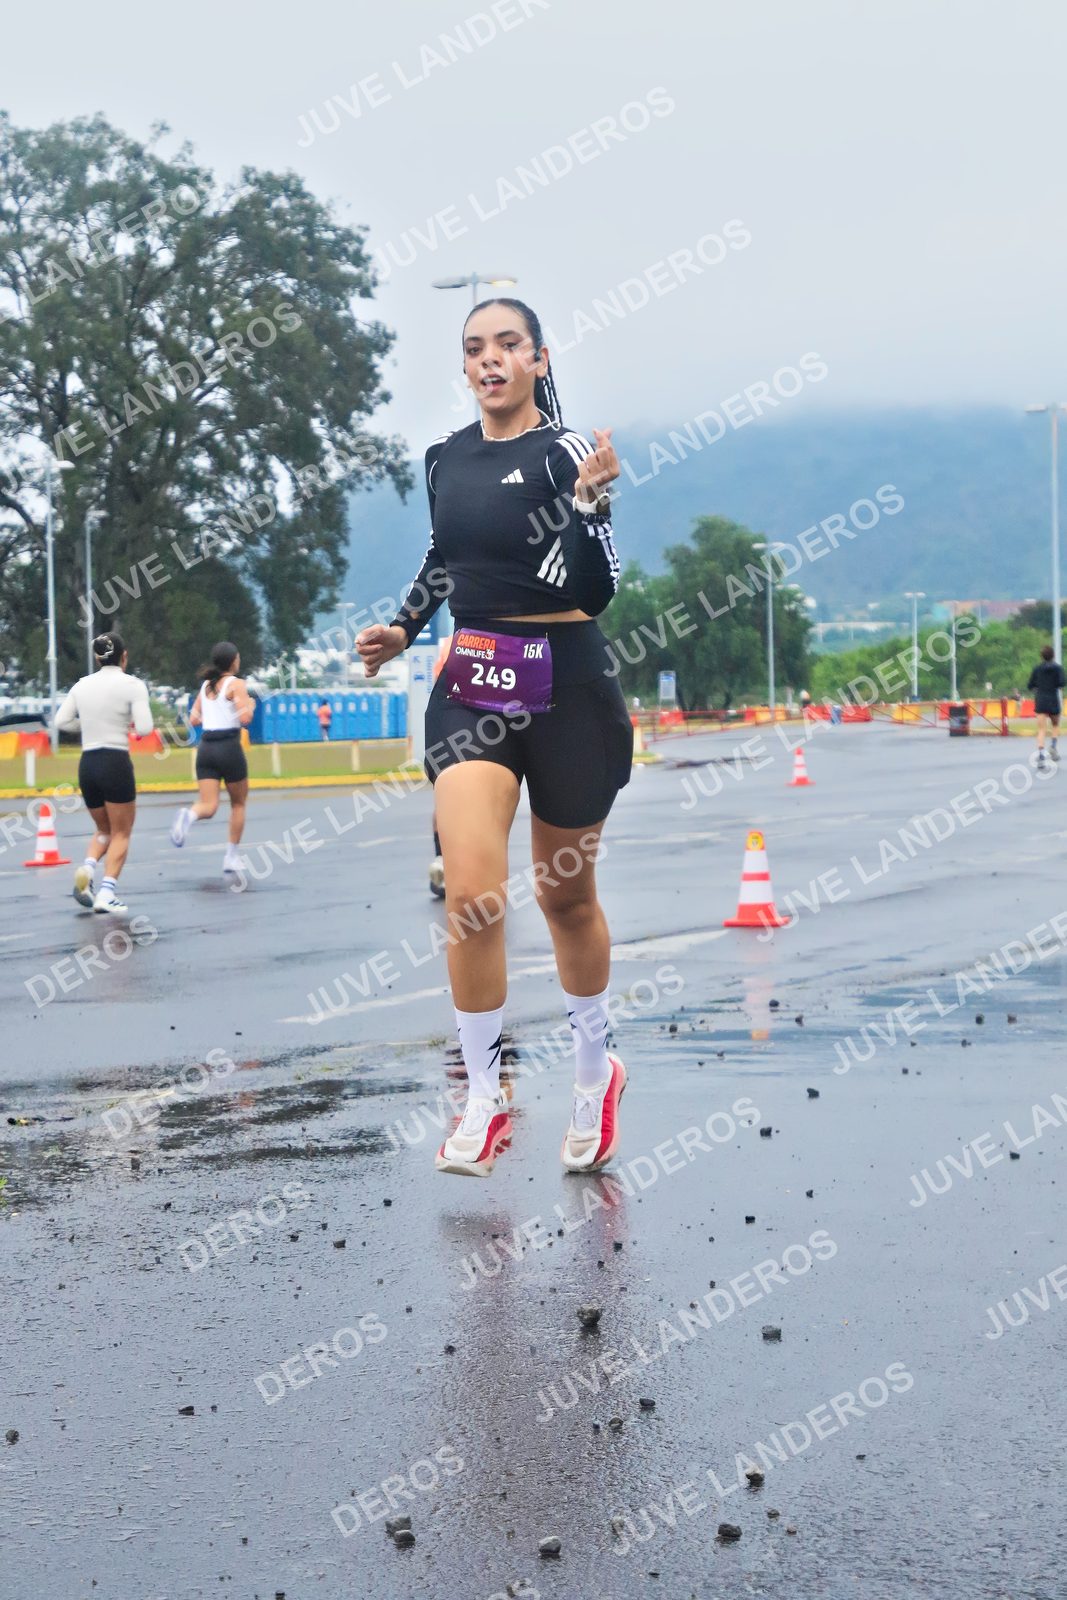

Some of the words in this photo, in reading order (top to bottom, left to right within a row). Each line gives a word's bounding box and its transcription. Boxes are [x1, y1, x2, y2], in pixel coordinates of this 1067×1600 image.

[457, 634, 496, 650] CARRERA
[523, 643, 543, 659] 15K
[471, 663, 516, 690] 249
